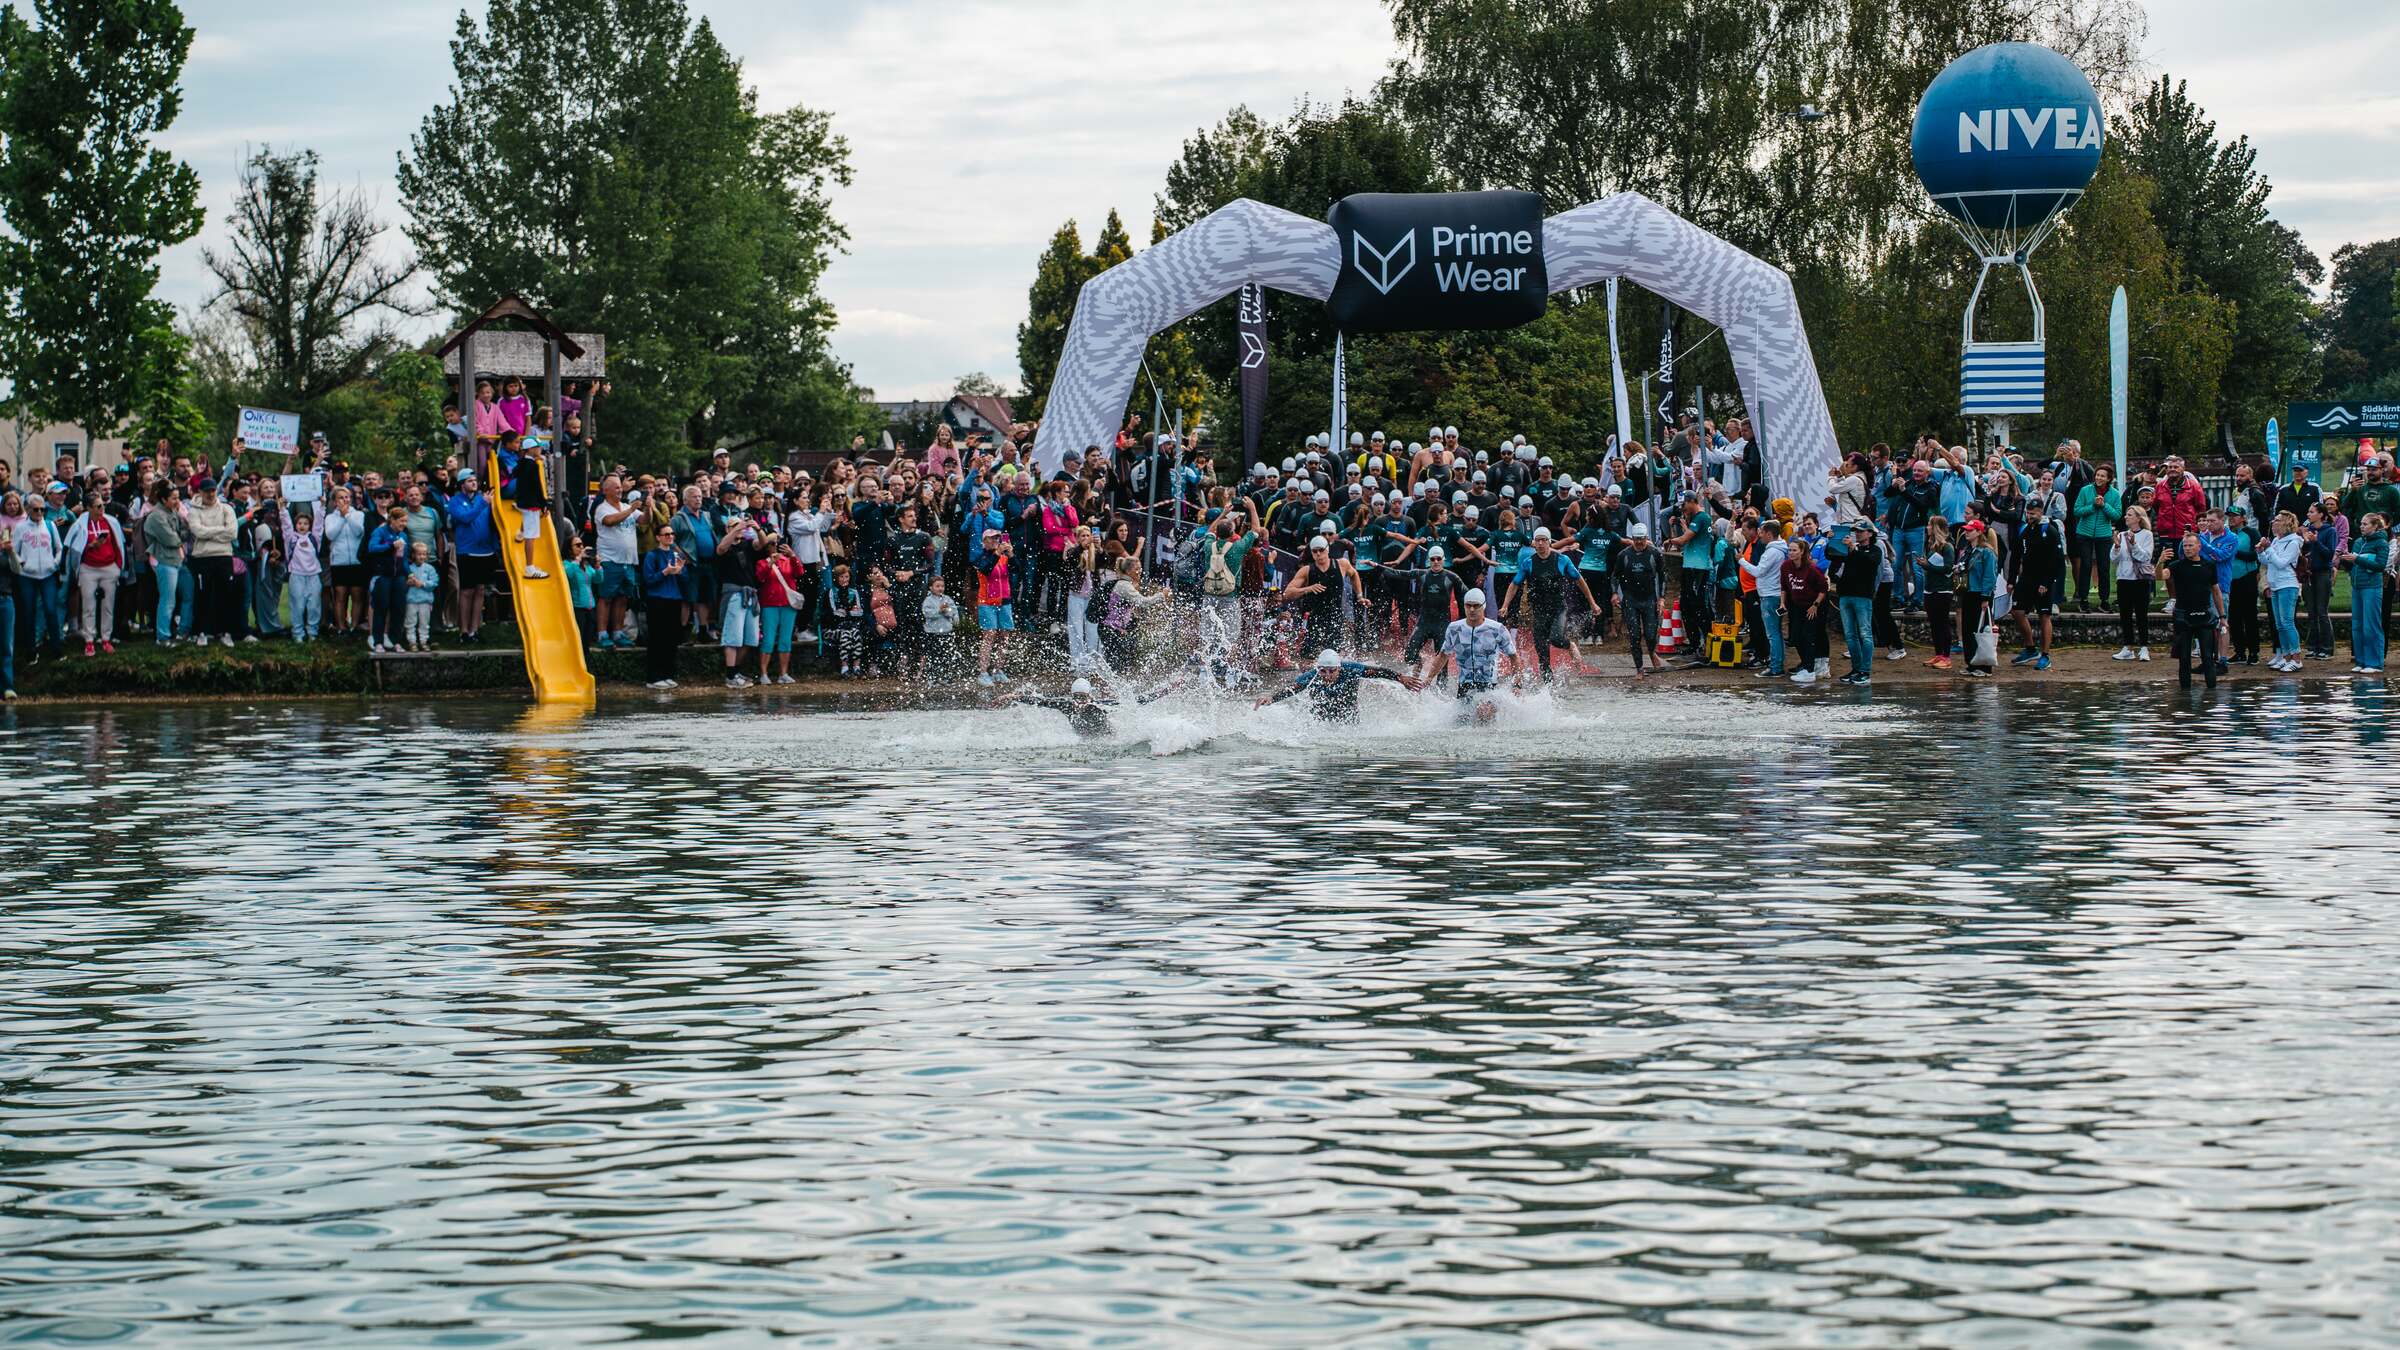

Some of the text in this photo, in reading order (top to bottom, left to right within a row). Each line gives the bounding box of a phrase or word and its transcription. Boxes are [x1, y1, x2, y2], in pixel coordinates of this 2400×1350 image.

[1958, 105, 2101, 153] NIVEA
[1432, 224, 1533, 257] Prime
[1434, 261, 1527, 293] Wear
[2361, 413, 2399, 421] Triathlon
[1353, 535, 1374, 543] CREW
